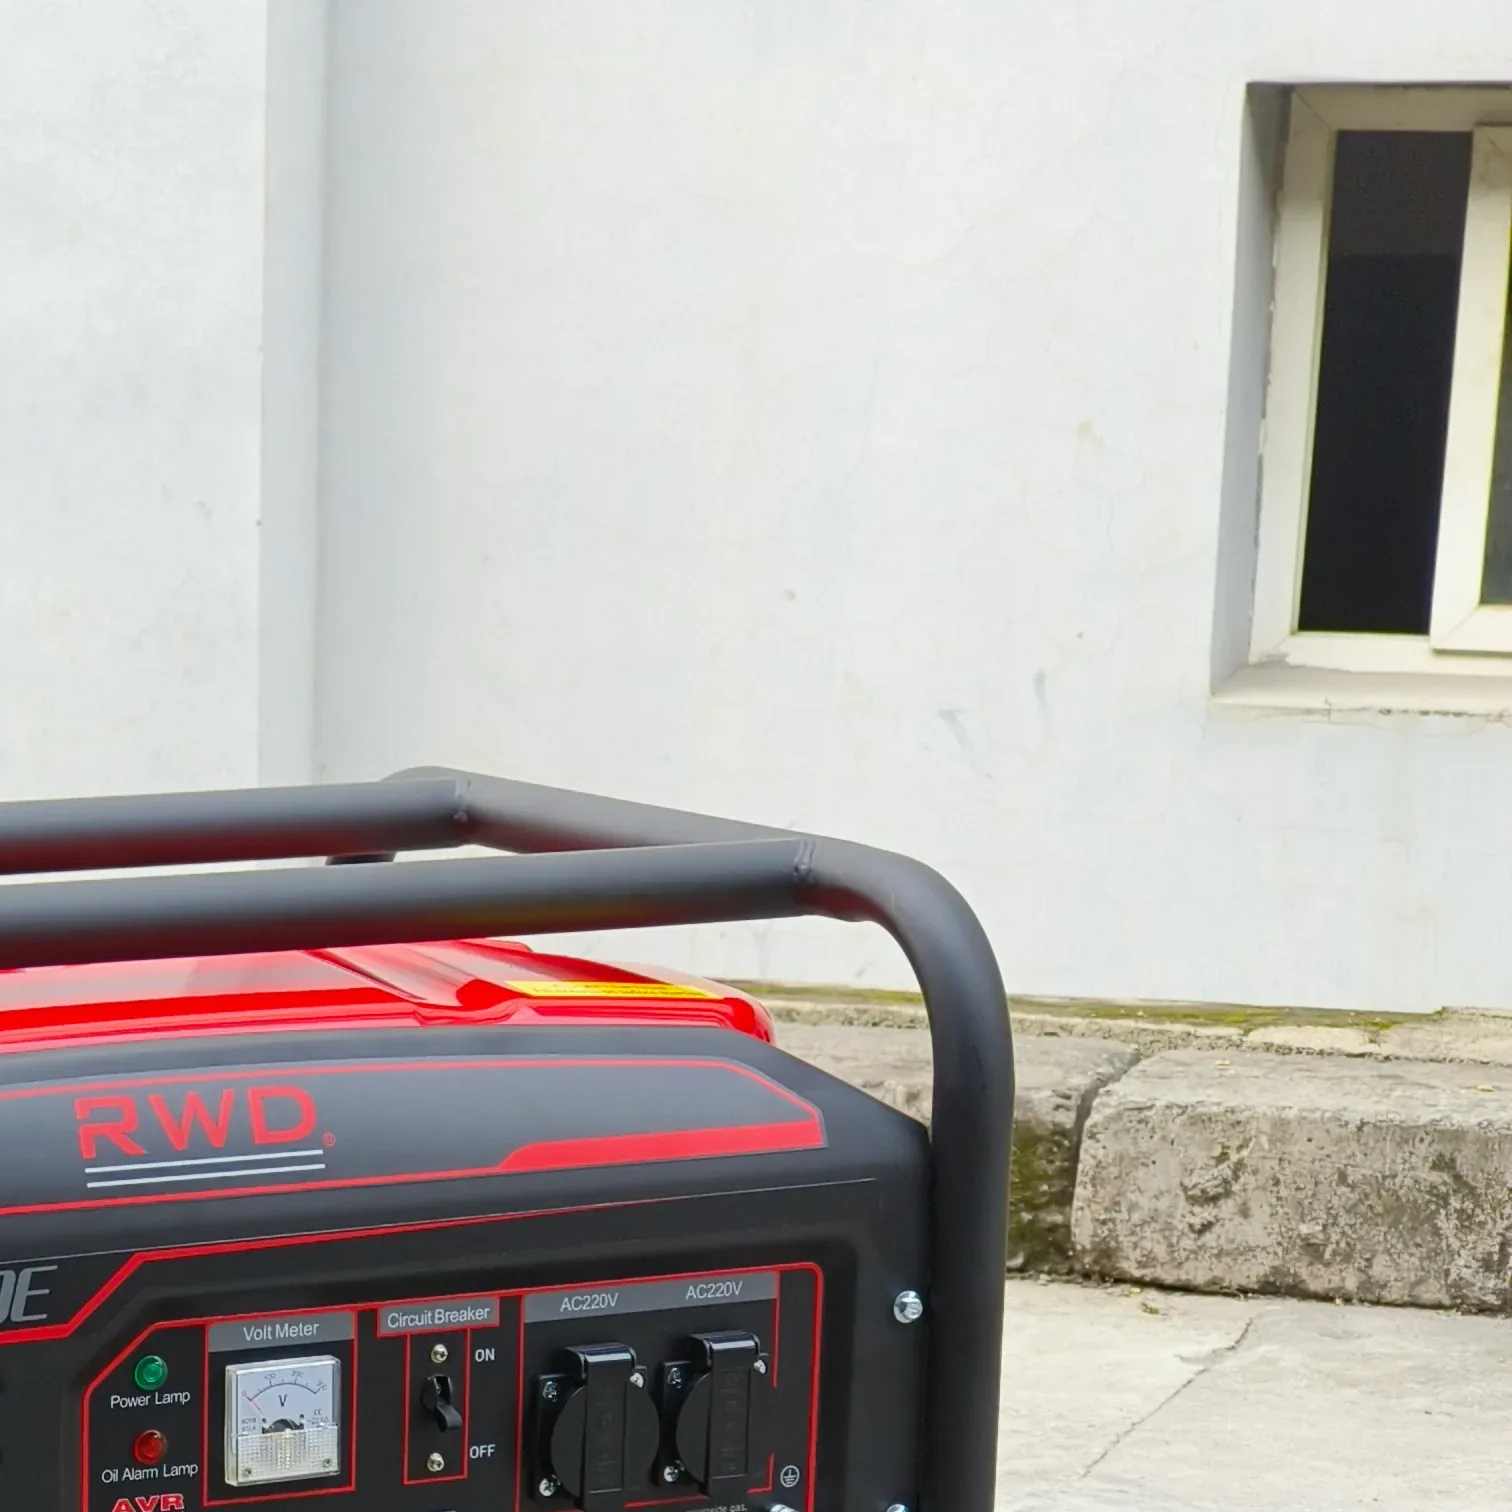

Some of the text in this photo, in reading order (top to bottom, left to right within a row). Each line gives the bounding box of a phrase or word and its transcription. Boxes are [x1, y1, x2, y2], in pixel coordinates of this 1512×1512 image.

[686, 1281, 743, 1300] AC220V
[560, 1293, 619, 1312] AC220V
[387, 1306, 490, 1328] Circuit Breaker
[243, 1323, 319, 1342] Volt Meter
[475, 1348, 495, 1362] ON
[111, 1391, 191, 1408] Power Lamp
[278, 1394, 288, 1407] V
[469, 1444, 496, 1459] OFF
[101, 1469, 119, 1483] Oil
[163, 1464, 199, 1477] Lamp
